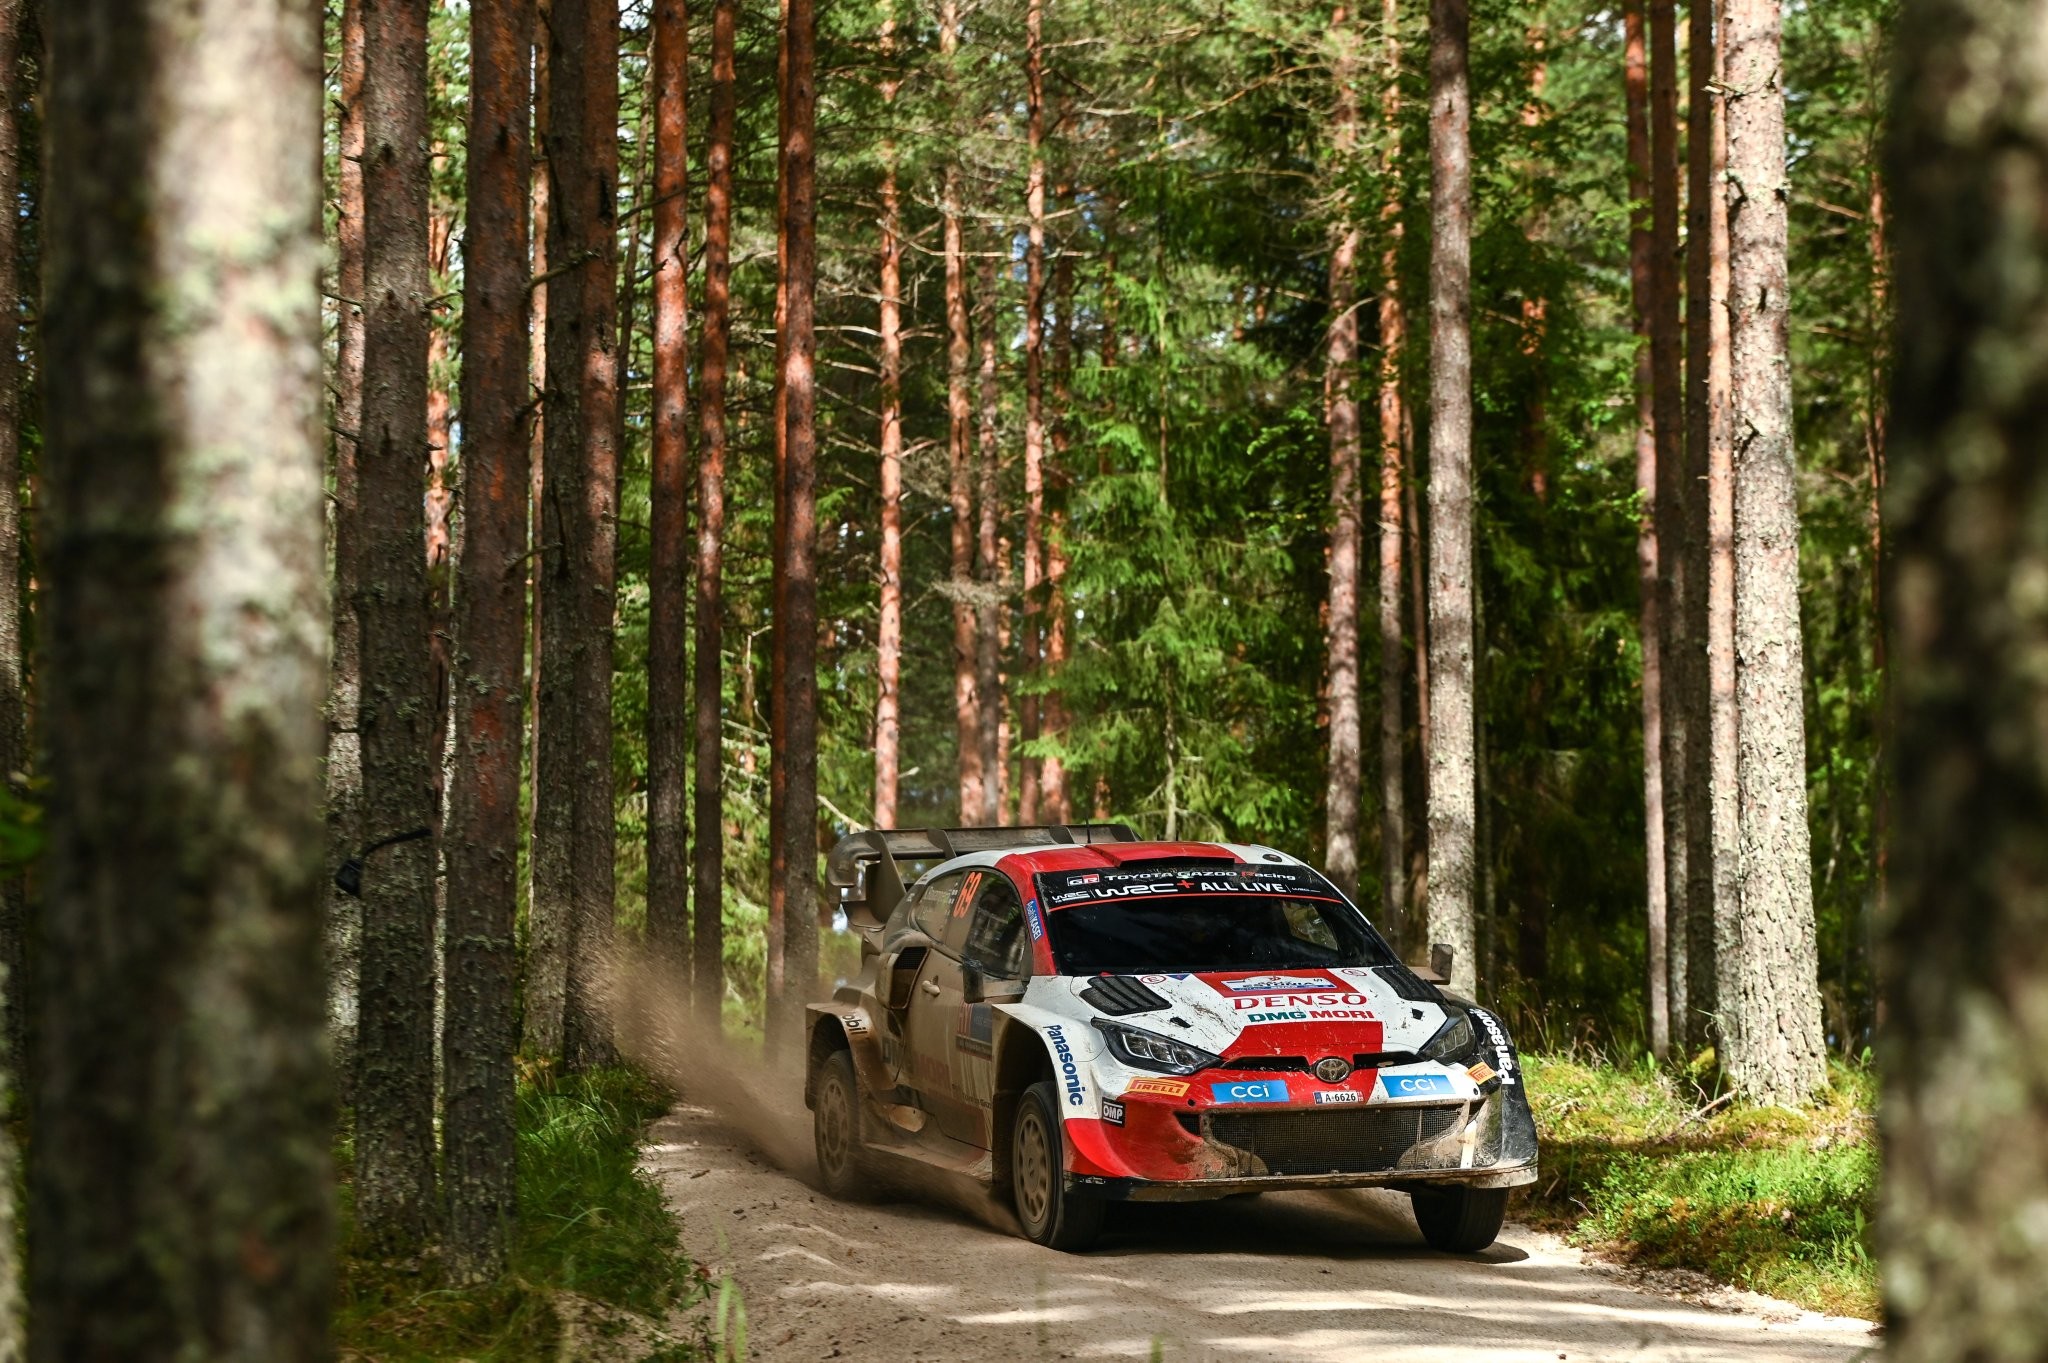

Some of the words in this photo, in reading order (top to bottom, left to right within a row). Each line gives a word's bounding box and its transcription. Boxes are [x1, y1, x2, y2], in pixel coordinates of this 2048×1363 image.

[1105, 872, 1173, 881] TOYOTA
[1177, 870, 1238, 878] GAZOO
[1241, 871, 1296, 881] Racing
[953, 871, 983, 919] 69
[1201, 881, 1239, 892] ALL
[1241, 882, 1287, 893] LIVE
[1233, 994, 1368, 1010] DENSO
[841, 1011, 868, 1035] obil
[1247, 1011, 1307, 1023] DMG
[1309, 1010, 1375, 1020] MORI
[1043, 1024, 1086, 1106] Panasonic
[1130, 1079, 1184, 1094] PIRELLI
[1103, 1104, 1123, 1120] OMP
